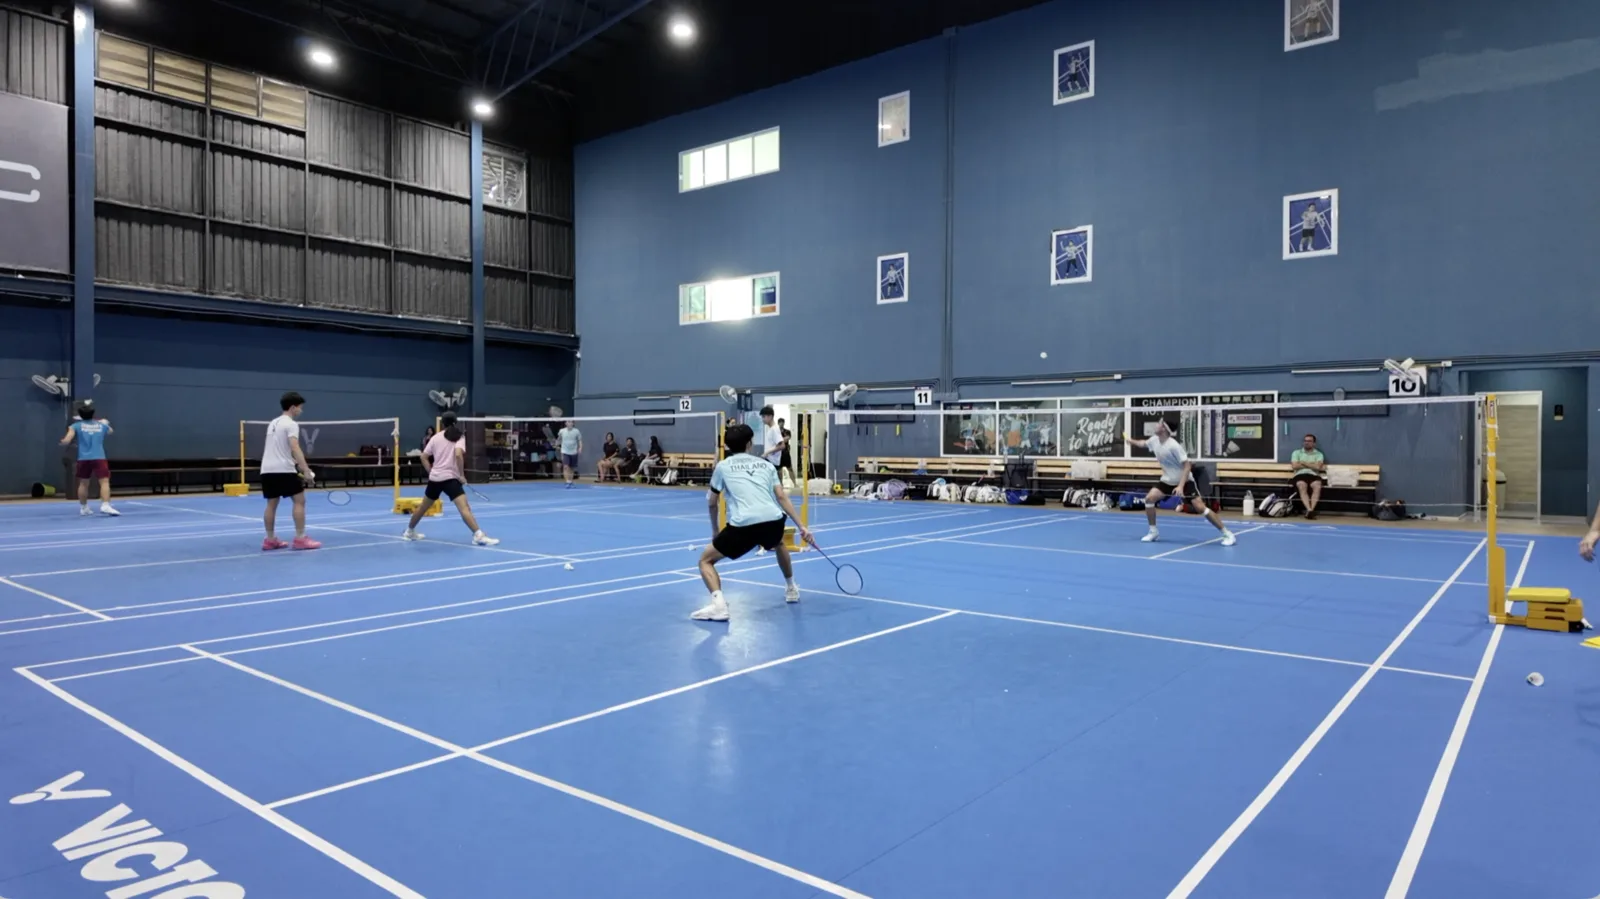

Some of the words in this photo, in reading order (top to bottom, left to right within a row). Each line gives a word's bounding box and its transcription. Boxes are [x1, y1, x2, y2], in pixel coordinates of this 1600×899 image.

[1392, 378, 1417, 393] 10
[917, 392, 928, 403] 11
[1142, 398, 1197, 407] CHAMPION
[681, 400, 690, 410] 12
[1077, 412, 1119, 436] Ready
[1068, 434, 1082, 451] to
[1087, 429, 1114, 448] Win
[730, 462, 768, 471] THAILAND
